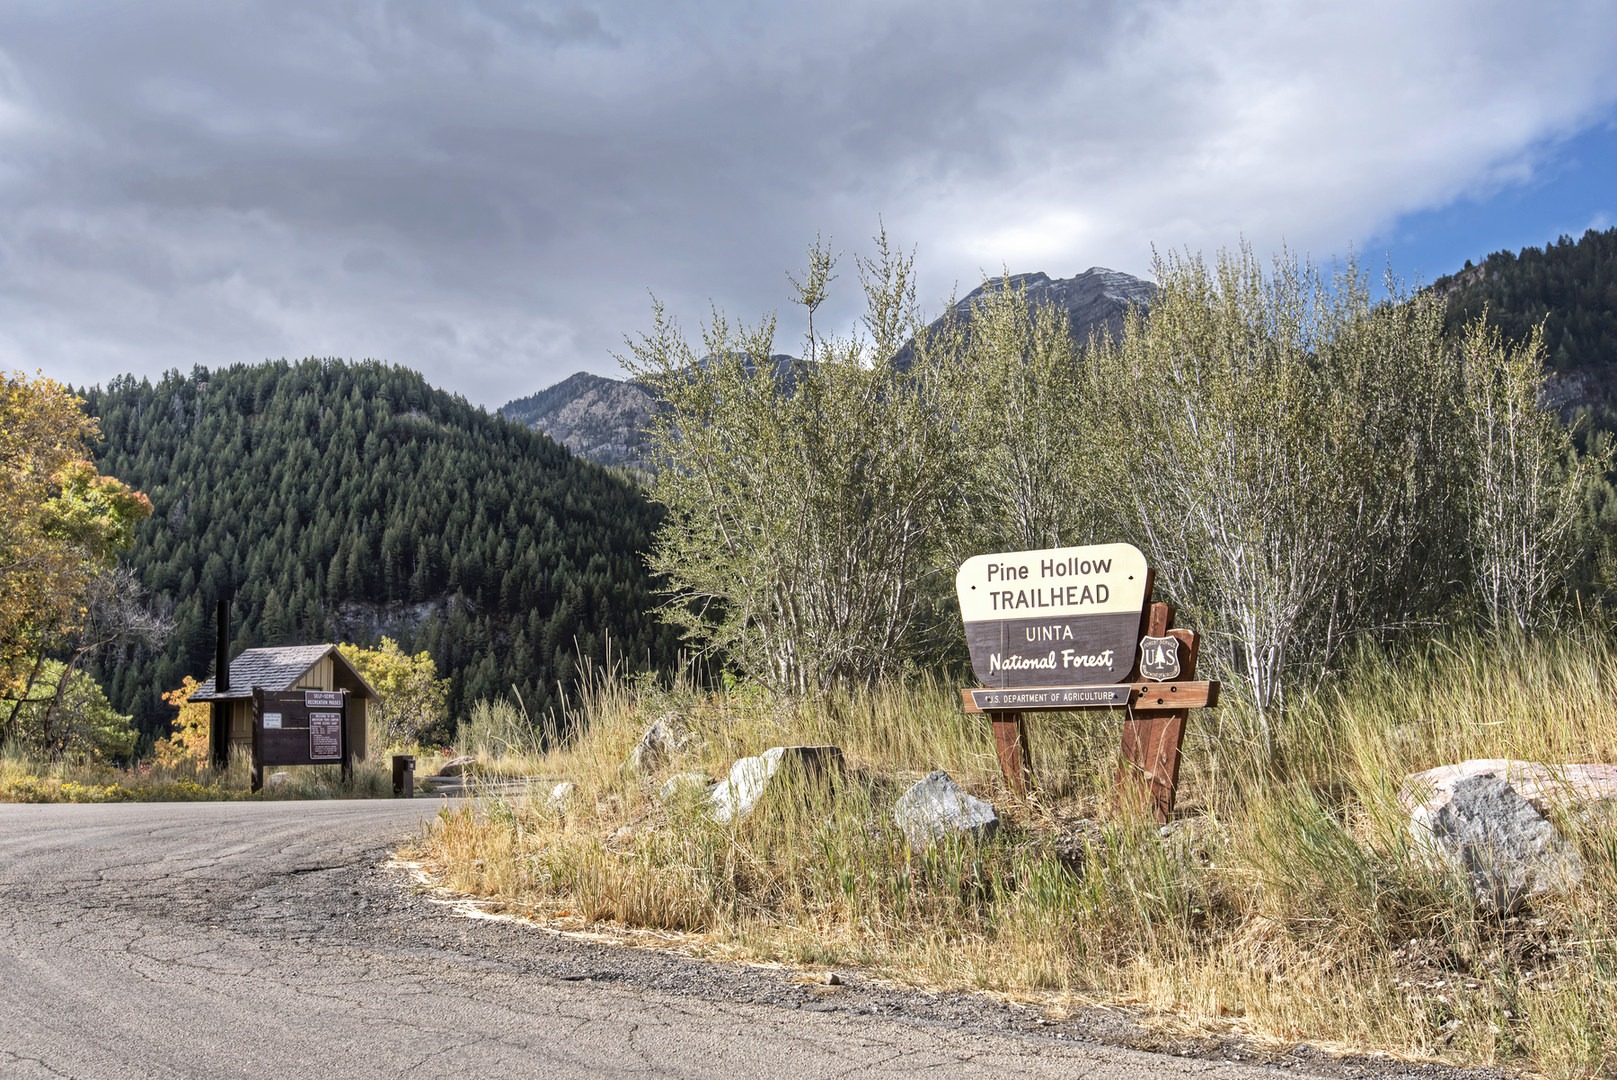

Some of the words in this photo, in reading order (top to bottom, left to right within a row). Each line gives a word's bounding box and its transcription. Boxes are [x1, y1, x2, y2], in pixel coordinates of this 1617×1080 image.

[987, 562, 1029, 582] Pine
[1041, 557, 1113, 578] Hollow
[990, 584, 1110, 610] TRAILHEAD
[1026, 625, 1073, 642] UINTA
[990, 650, 1057, 672] National
[1061, 648, 1114, 669] Forest
[1004, 694, 1048, 703] DEPARTMENT
[1050, 692, 1060, 702] OF
[1064, 691, 1113, 702] AGRICULTURE
